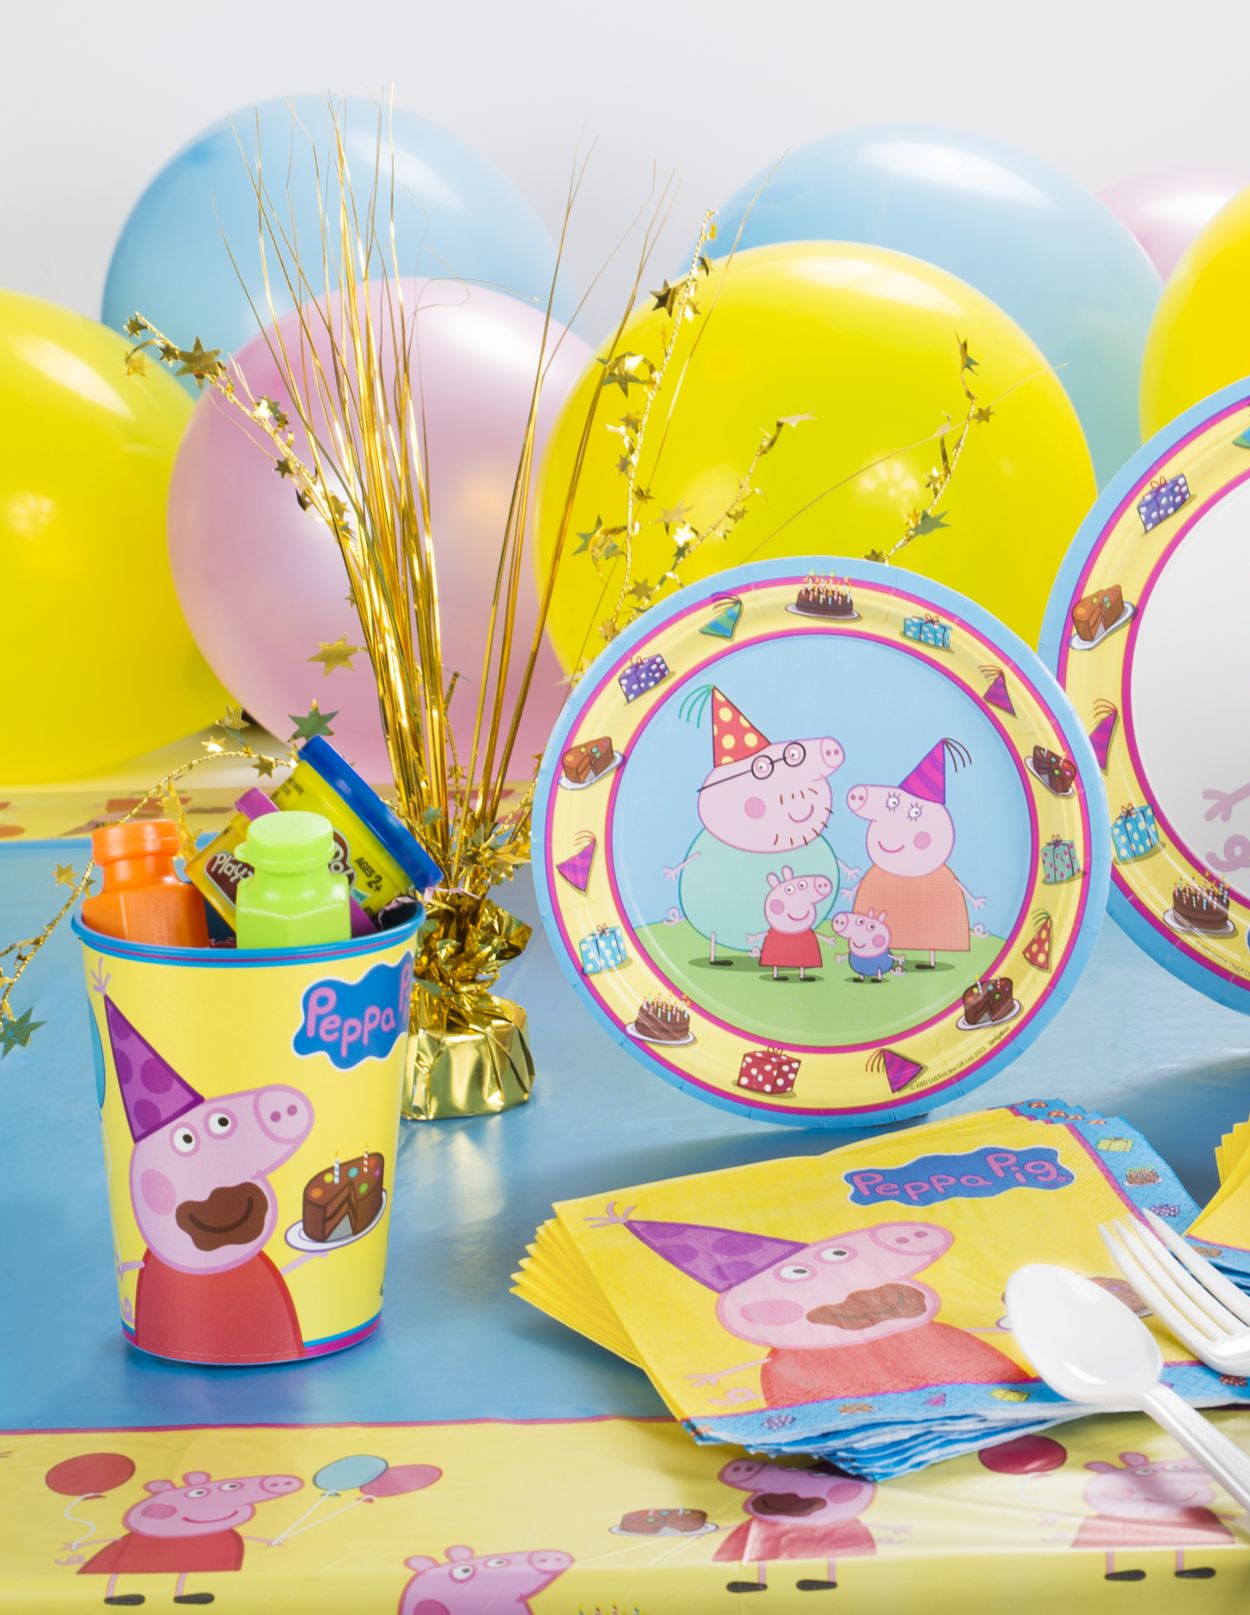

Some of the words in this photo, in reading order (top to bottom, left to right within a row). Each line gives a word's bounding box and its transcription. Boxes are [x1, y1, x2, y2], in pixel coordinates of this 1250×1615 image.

[354, 857, 376, 878] AGES
[366, 874, 383, 892] 2+
[305, 986, 396, 1058] Peppa
[851, 1172, 993, 1201] Peppa
[985, 1152, 1070, 1183] Pig
